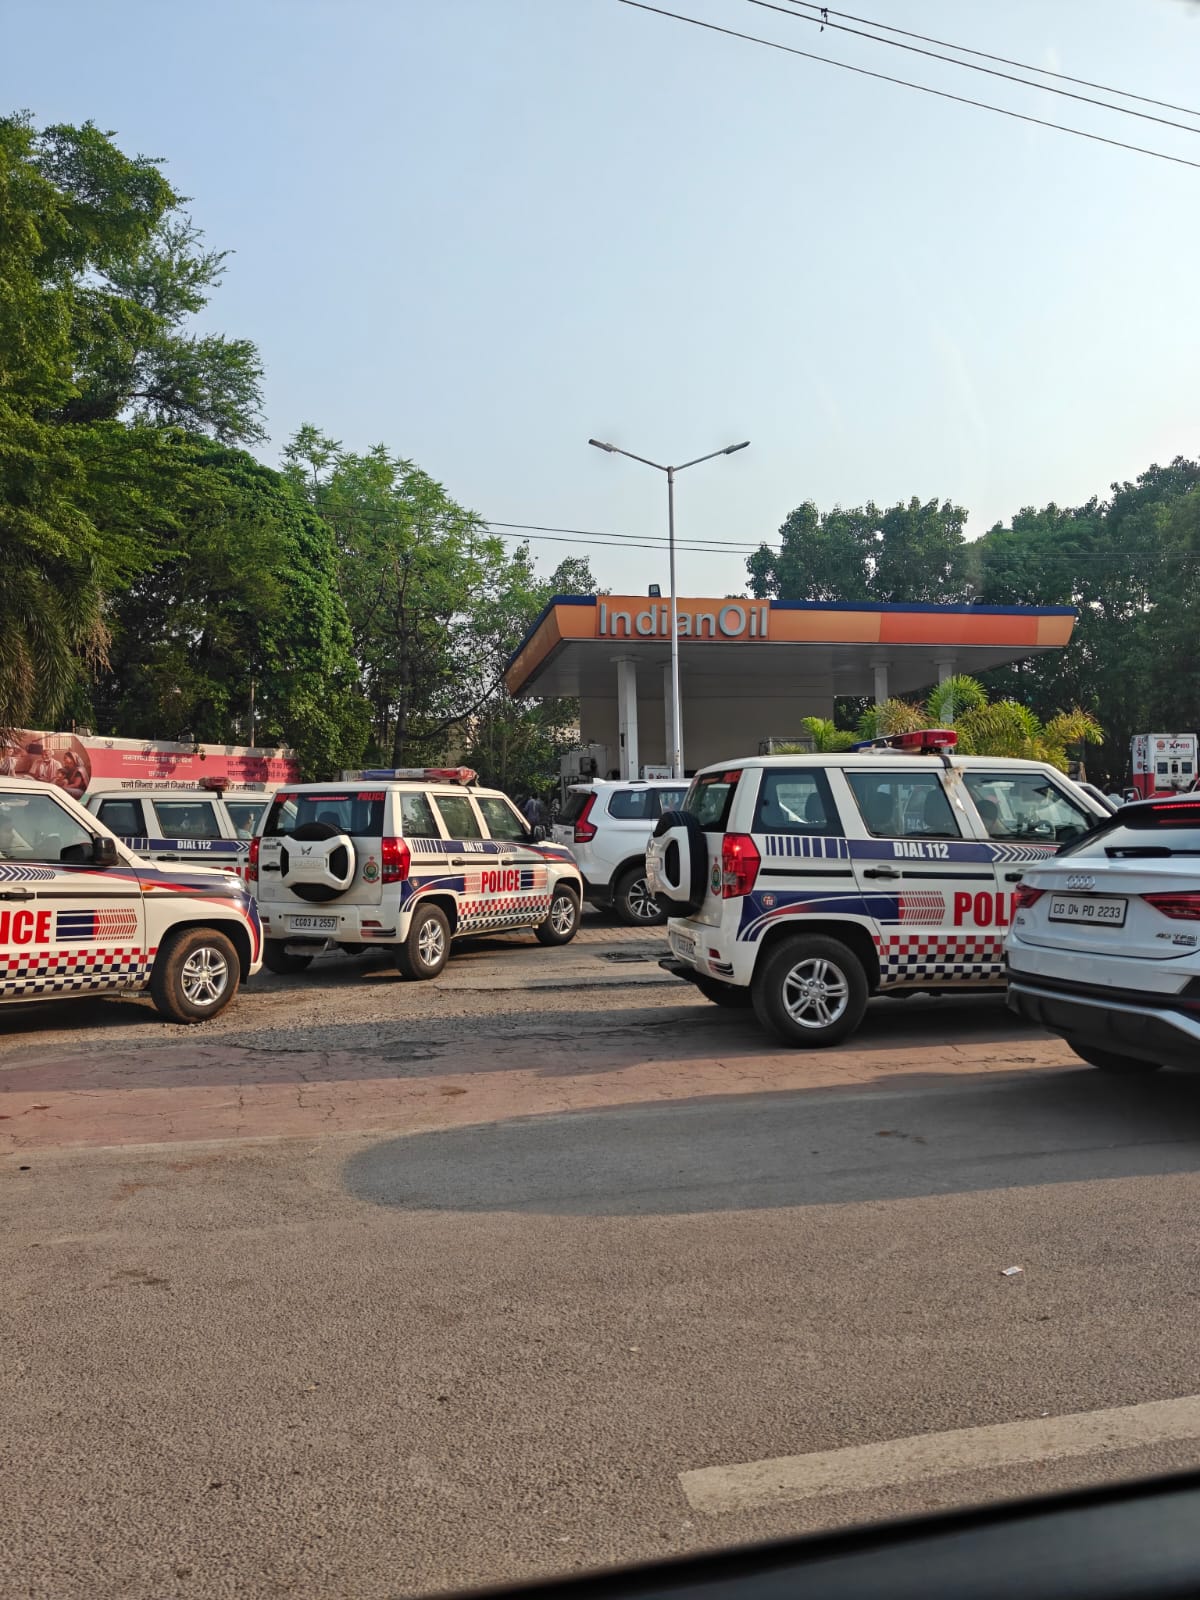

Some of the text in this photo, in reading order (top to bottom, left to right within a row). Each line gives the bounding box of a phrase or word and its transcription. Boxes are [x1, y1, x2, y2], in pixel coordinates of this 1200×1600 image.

[600, 603, 768, 637] IndianOil
[177, 840, 212, 850] DIAL 112
[893, 841, 950, 859] DIAL 112
[481, 869, 521, 894] POLICE
[1053, 903, 1066, 914] CG
[1068, 904, 1079, 915] 04
[1097, 906, 1121, 919] 2233
